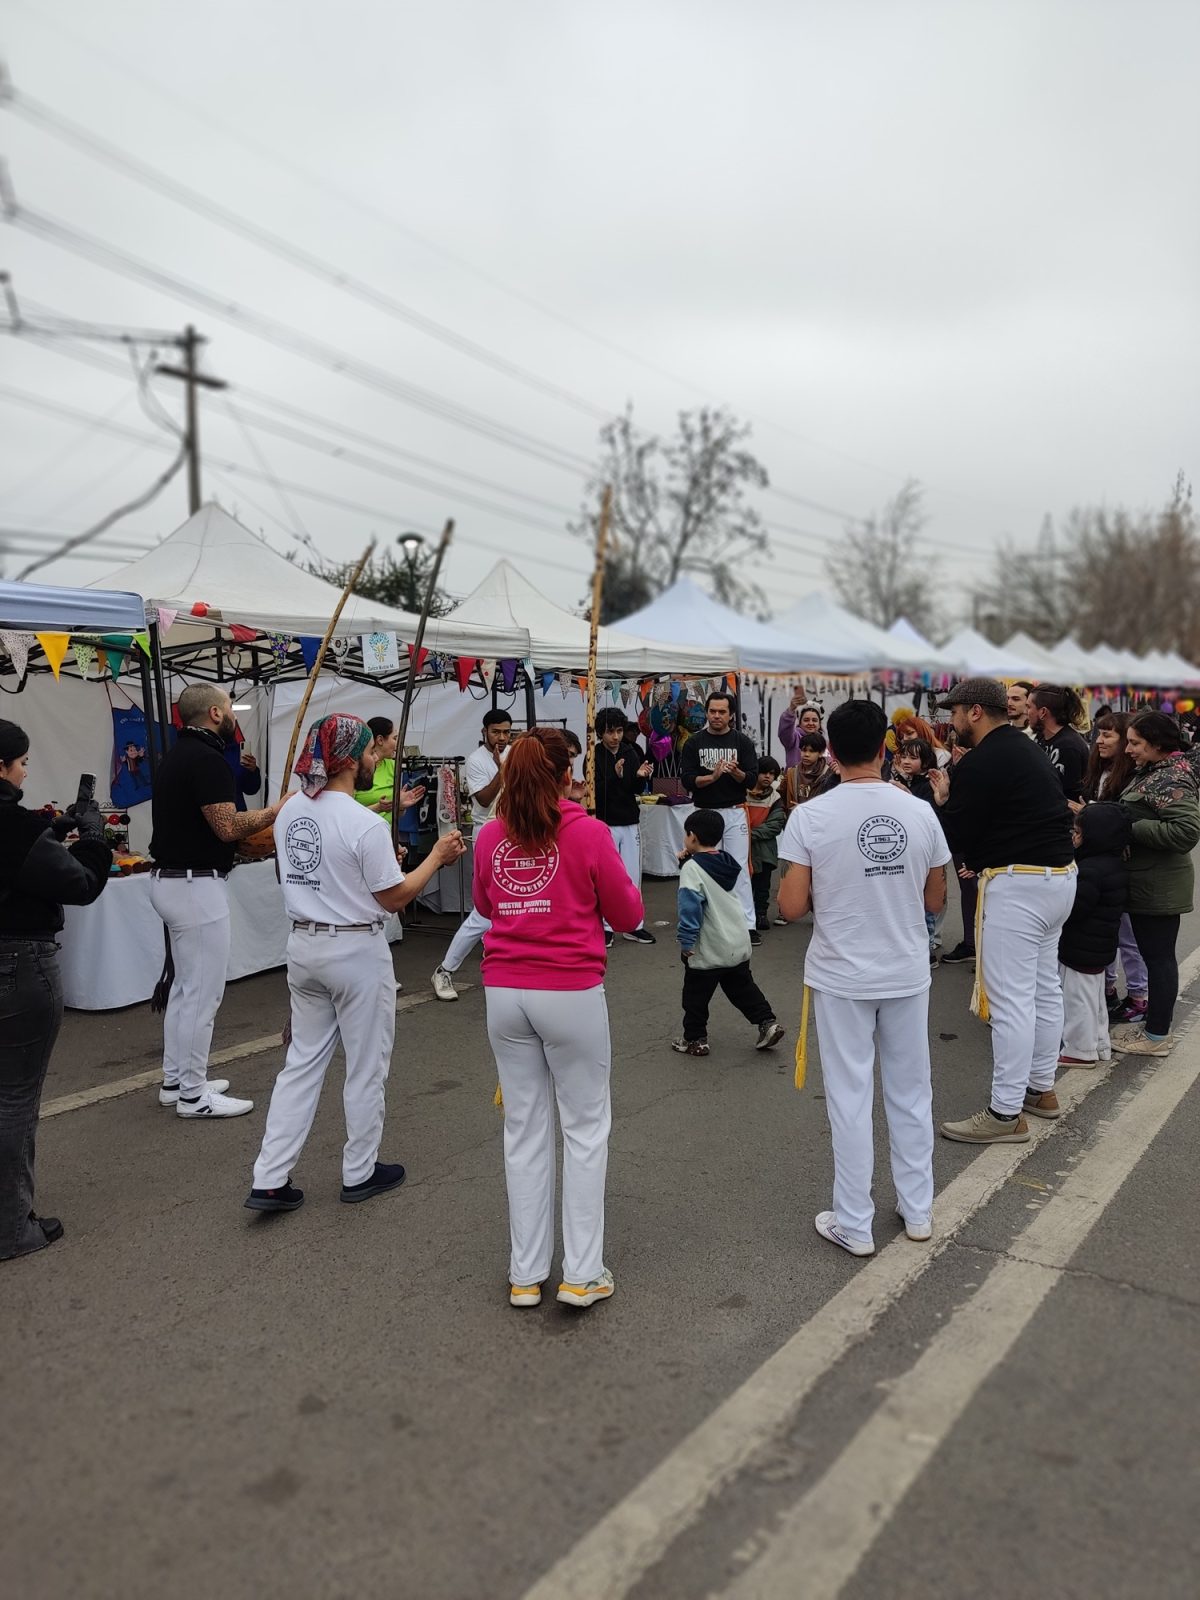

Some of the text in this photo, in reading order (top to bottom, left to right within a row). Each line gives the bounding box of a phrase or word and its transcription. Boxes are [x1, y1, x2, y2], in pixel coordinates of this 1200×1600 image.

[493, 841, 512, 874] GRUPO
[866, 848, 901, 860] CAPOEIRA
[514, 859, 536, 868] 1963
[548, 856, 555, 869] DE
[501, 875, 548, 893] CAPOEIRA
[498, 901, 522, 909] MESTRE
